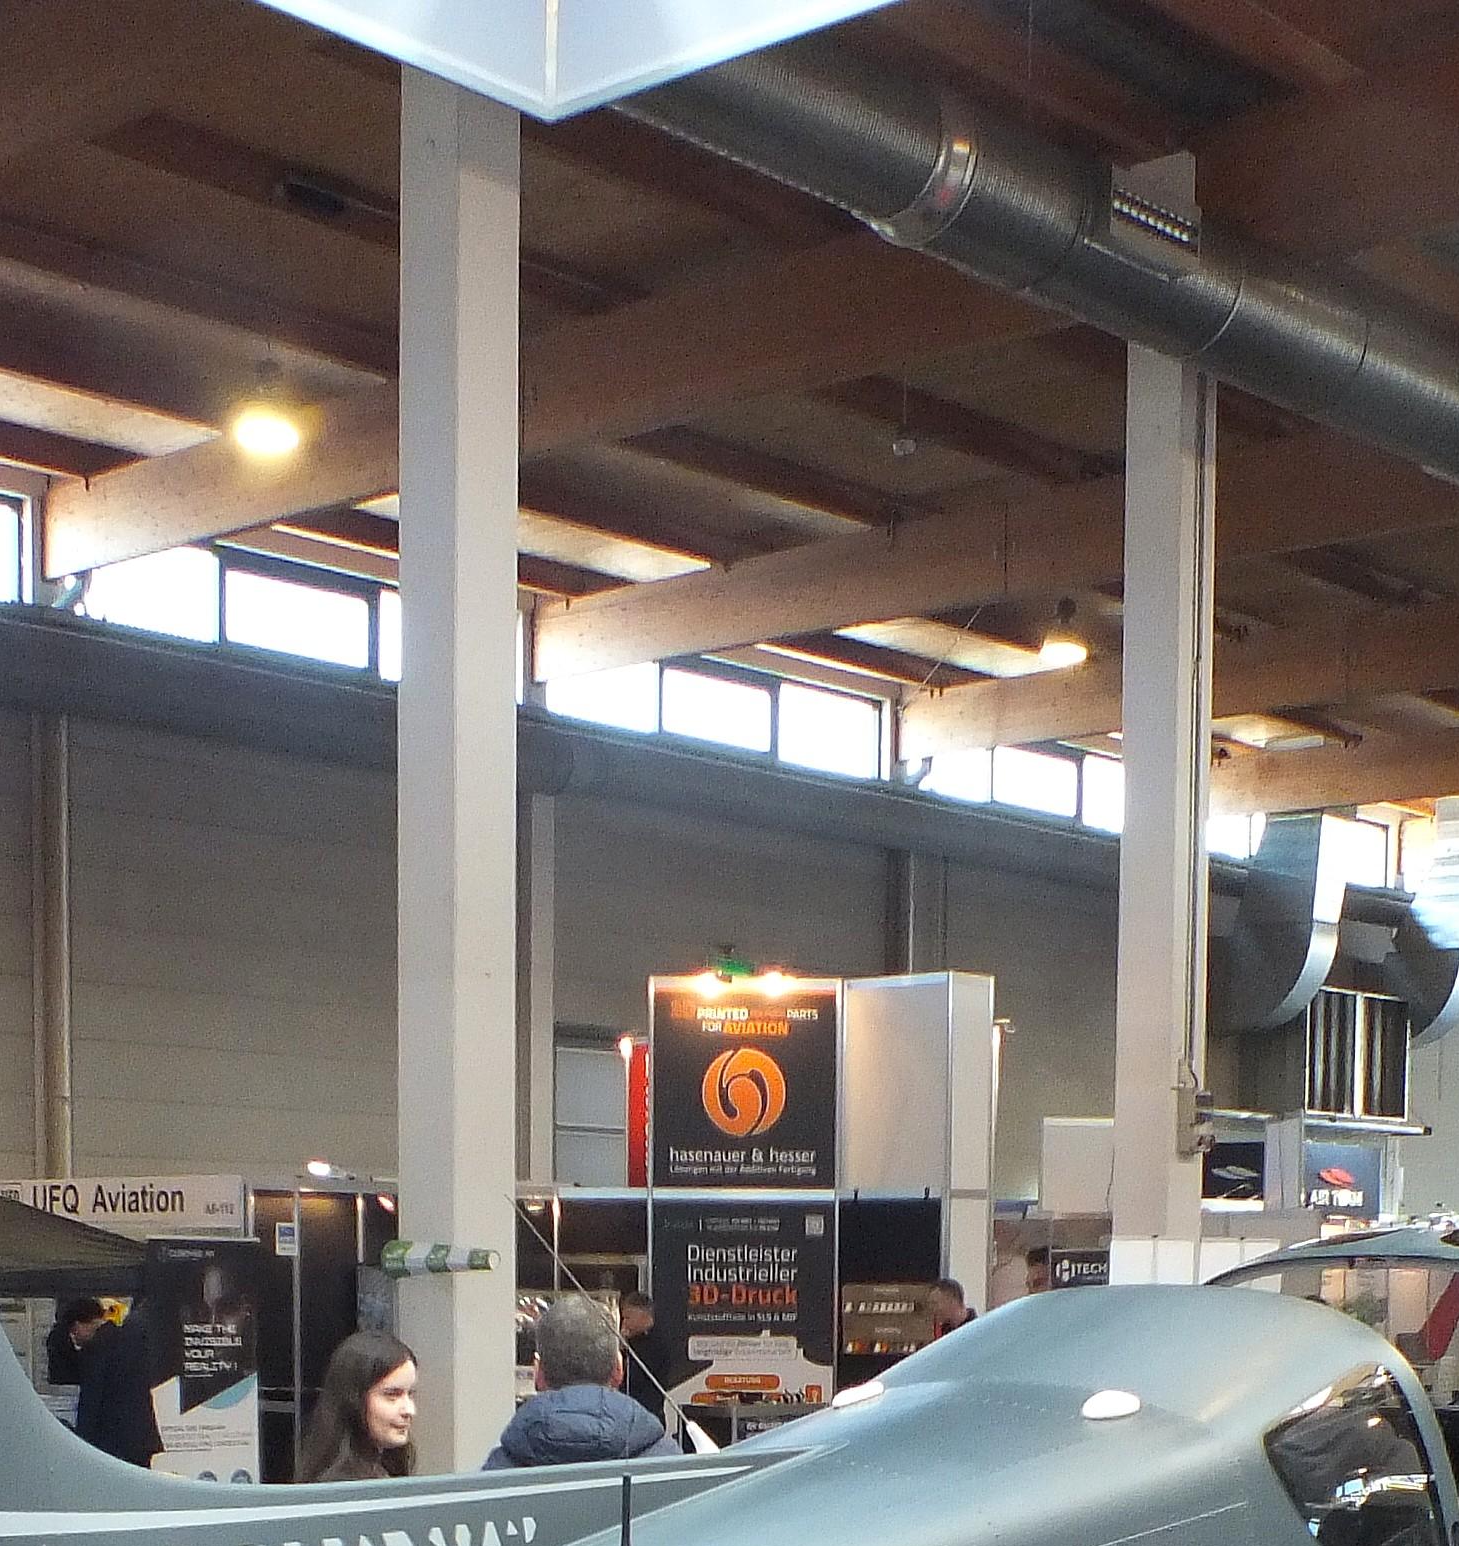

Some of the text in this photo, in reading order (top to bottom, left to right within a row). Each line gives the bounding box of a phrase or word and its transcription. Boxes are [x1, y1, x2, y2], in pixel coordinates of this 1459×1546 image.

[786, 1008, 818, 1020] PARTS
[723, 1021, 787, 1035] AVIATION
[752, 1147, 764, 1162] &
[770, 1146, 816, 1162] hesser
[33, 1183, 185, 1215] UFQ Aviation
[688, 1244, 797, 1262] Dienstleister
[688, 1264, 797, 1283] Industrieller
[688, 1283, 797, 1305] 3D-Druck
